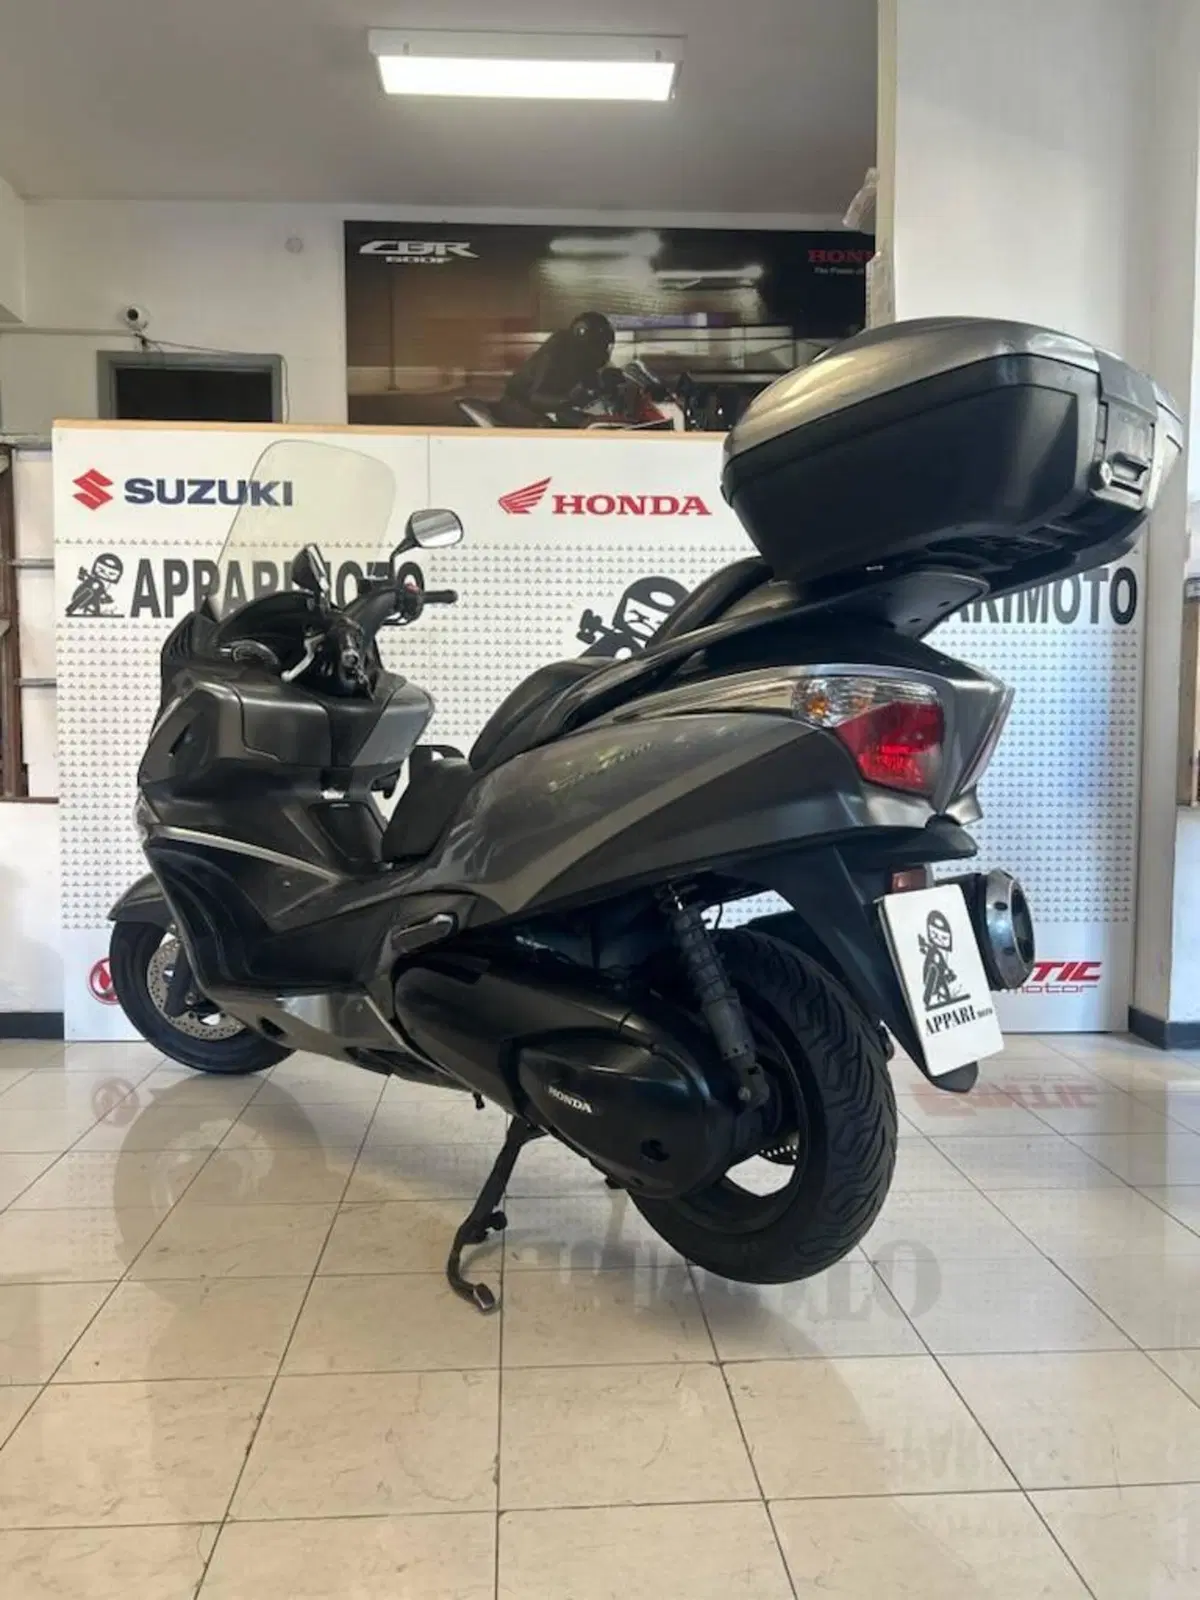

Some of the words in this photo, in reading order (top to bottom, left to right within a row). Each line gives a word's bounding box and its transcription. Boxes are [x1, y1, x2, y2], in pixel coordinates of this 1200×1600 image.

[359, 240, 480, 258] CBR
[124, 478, 293, 507] SUZUKI
[552, 494, 712, 516] HONDA
[1032, 962, 1103, 982] TIC
[925, 1004, 976, 1037] APPARI
[548, 1084, 594, 1114] HONDA
